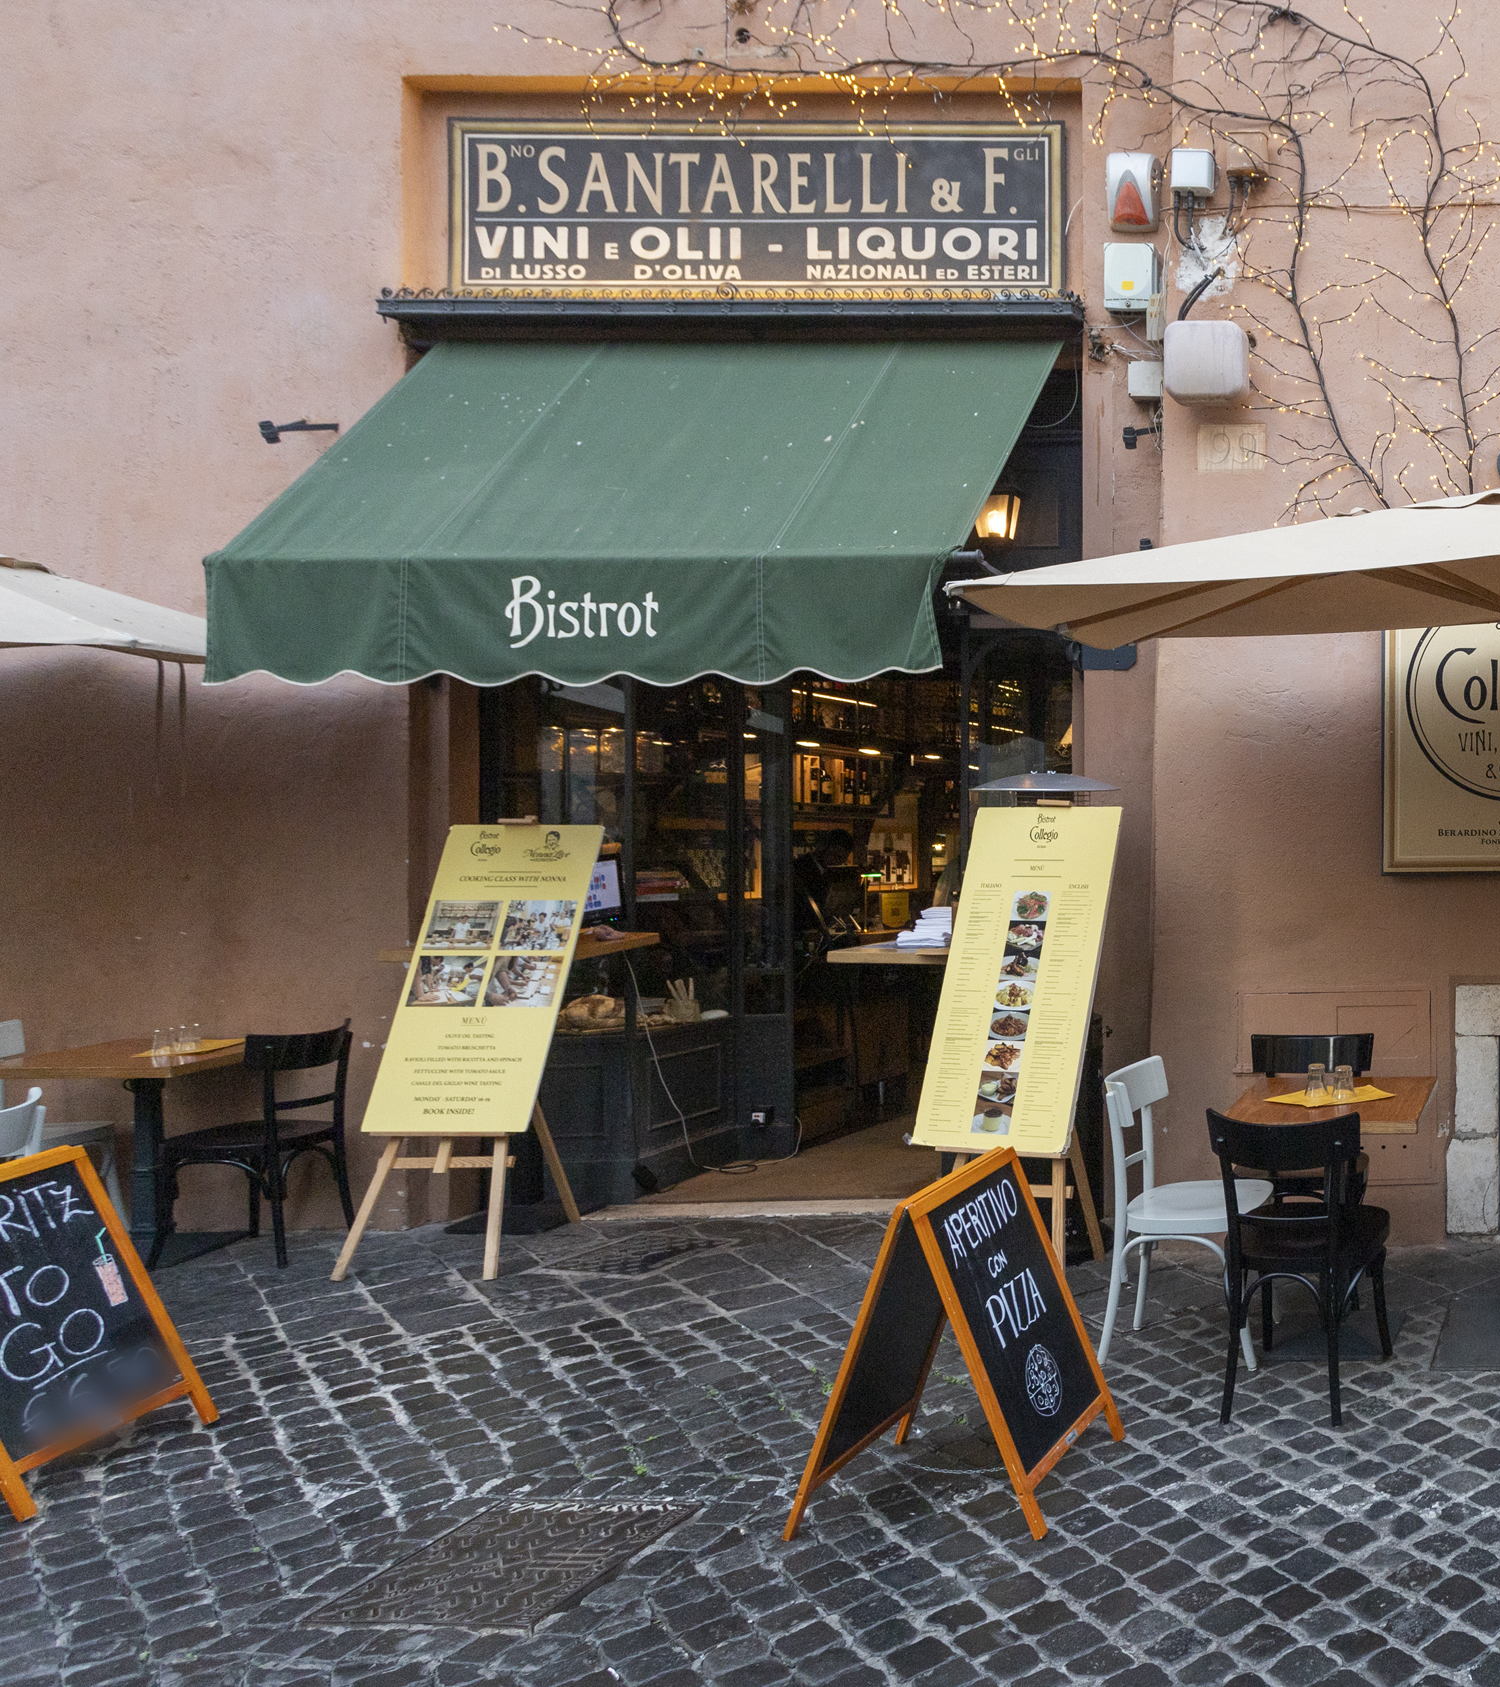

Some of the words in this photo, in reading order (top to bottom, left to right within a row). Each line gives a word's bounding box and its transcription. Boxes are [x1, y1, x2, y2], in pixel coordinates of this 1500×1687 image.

[537, 145, 909, 216] SANTARELLI
[930, 177, 964, 213] &
[475, 226, 589, 260] VINI
[604, 242, 619, 260] E
[630, 226, 742, 260] OLII
[806, 226, 1038, 260] LIQUORI
[480, 267, 501, 280] DI
[510, 264, 587, 280] LUSSO
[634, 265, 742, 280] D'OLIVA
[806, 265, 927, 280] NAZIONALI
[935, 269, 959, 280] ED
[967, 265, 1038, 280] ESTERI
[504, 575, 660, 649] Bistrot
[470, 841, 501, 857] Collegio
[1029, 825, 1059, 843] Collegio
[1438, 828, 1497, 837] BERARDINO
[942, 1178, 1018, 1270] APERITIVO
[985, 1267, 1048, 1350] PIZZA
[0, 1308, 105, 1381] GO
